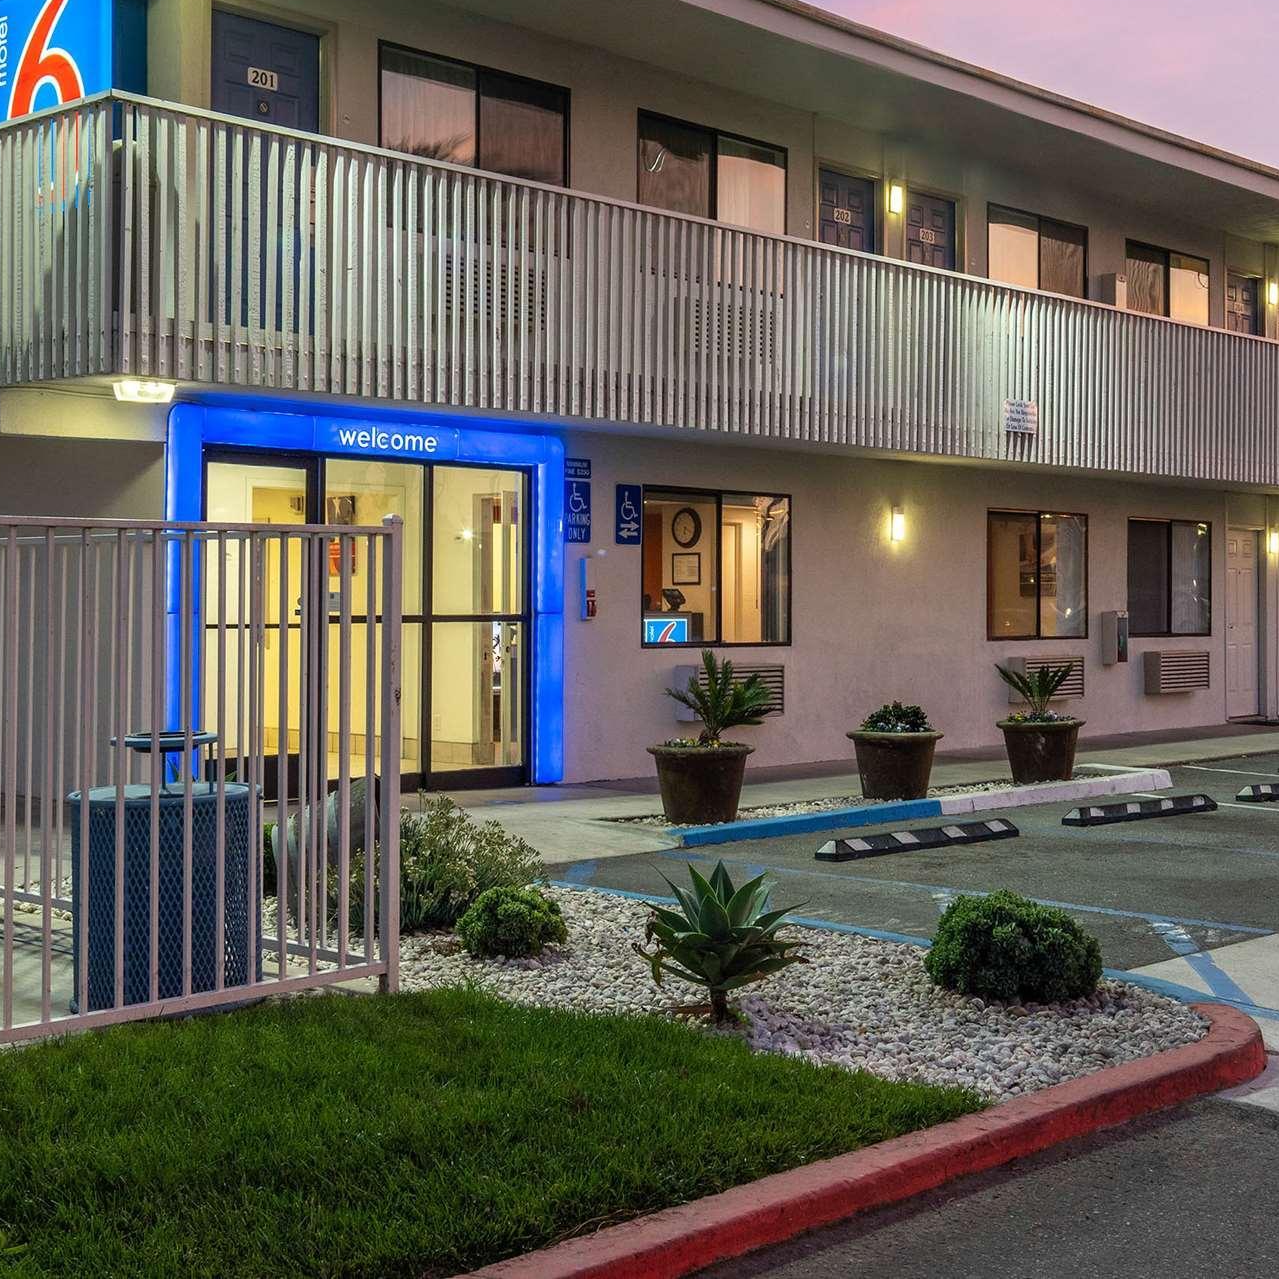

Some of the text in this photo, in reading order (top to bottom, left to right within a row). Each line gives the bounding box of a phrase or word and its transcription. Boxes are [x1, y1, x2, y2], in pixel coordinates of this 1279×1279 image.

[251, 70, 274, 88] 201
[835, 210, 850, 222] 202
[921, 231, 934, 242] 203
[339, 426, 438, 452] welcome
[568, 527, 586, 540] ONLY
